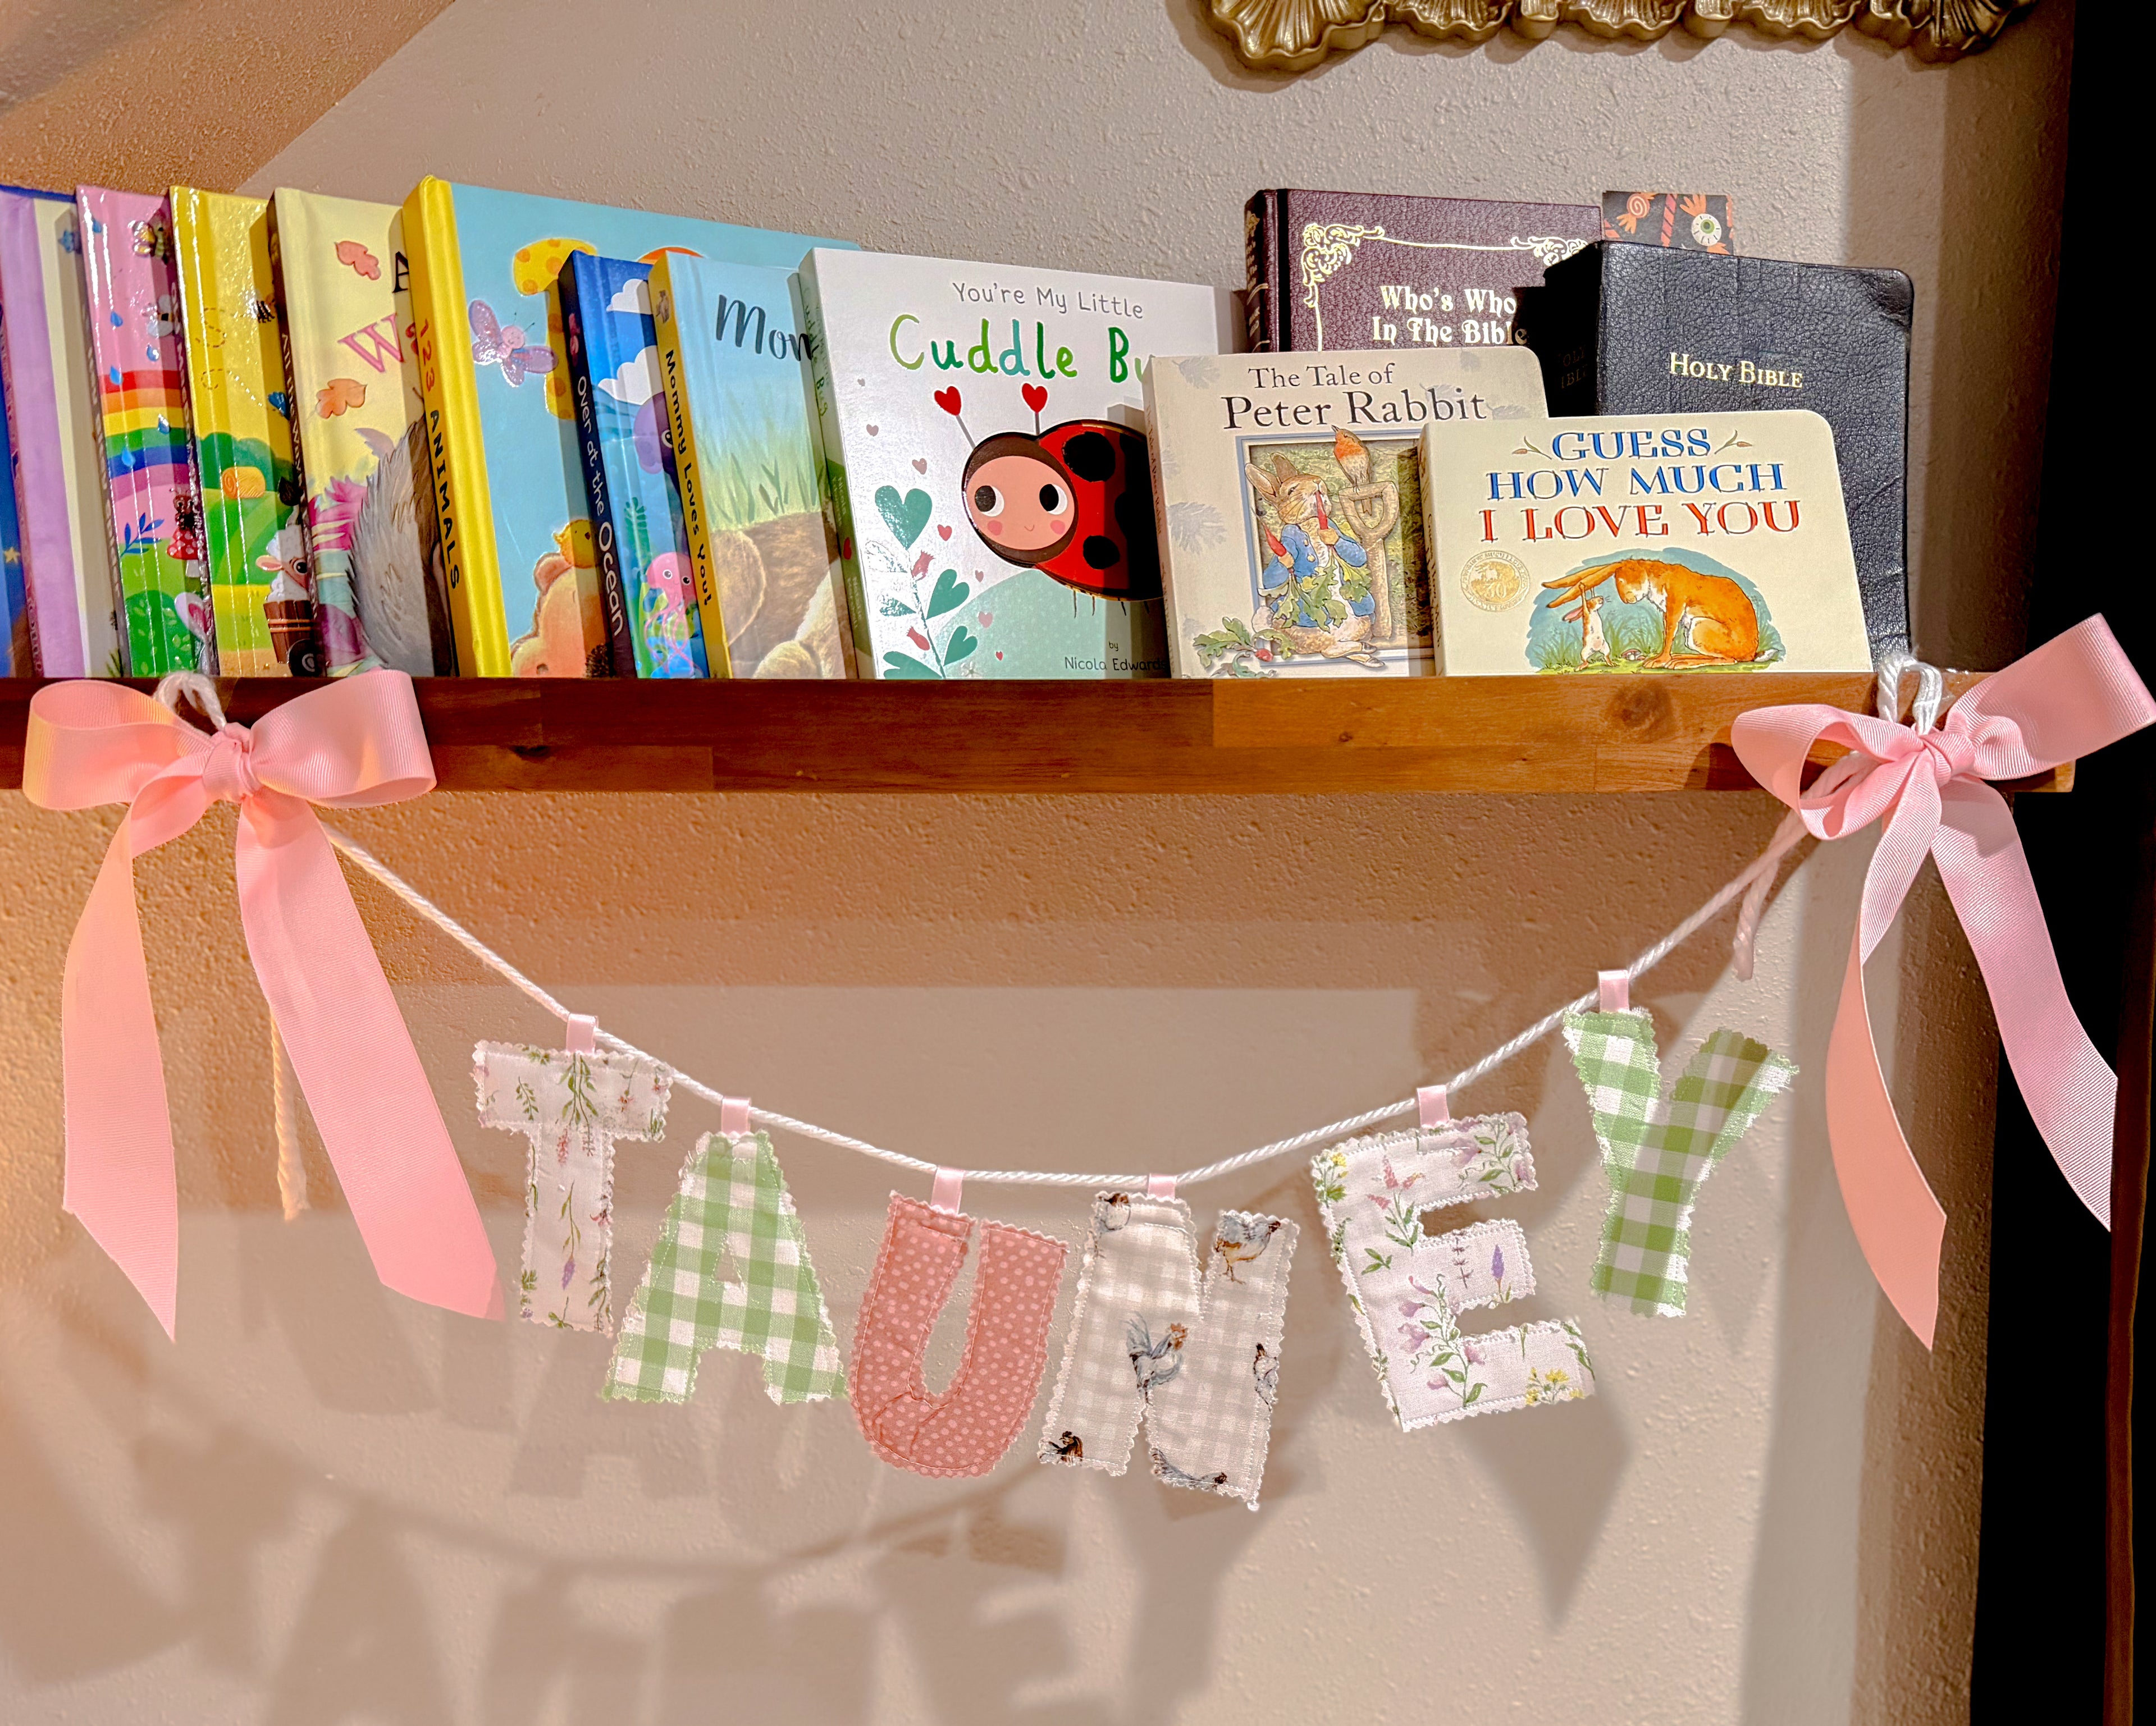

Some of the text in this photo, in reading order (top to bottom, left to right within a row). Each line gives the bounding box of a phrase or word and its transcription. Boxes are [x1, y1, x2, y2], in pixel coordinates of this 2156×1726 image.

[953, 281, 1143, 319] You're My Little
[1380, 285, 1518, 318] Who's Who
[890, 314, 1077, 379] Cuddle
[1372, 316, 1528, 347] In The Bible
[1249, 362, 1395, 390] The Tale of
[1221, 388, 1487, 429] Peter Rabbit
[1551, 429, 1712, 460] GUESS
[666, 349, 712, 606] Mommy Loves You!
[1486, 464, 1787, 501] HOW MUCH
[430, 409, 460, 588] ANIMALS
[577, 376, 623, 636] Over at the Ocean
[1479, 500, 1800, 542] I LOVE YOU
[1065, 657, 1107, 670] Nicola
[1109, 642, 1118, 651] by
